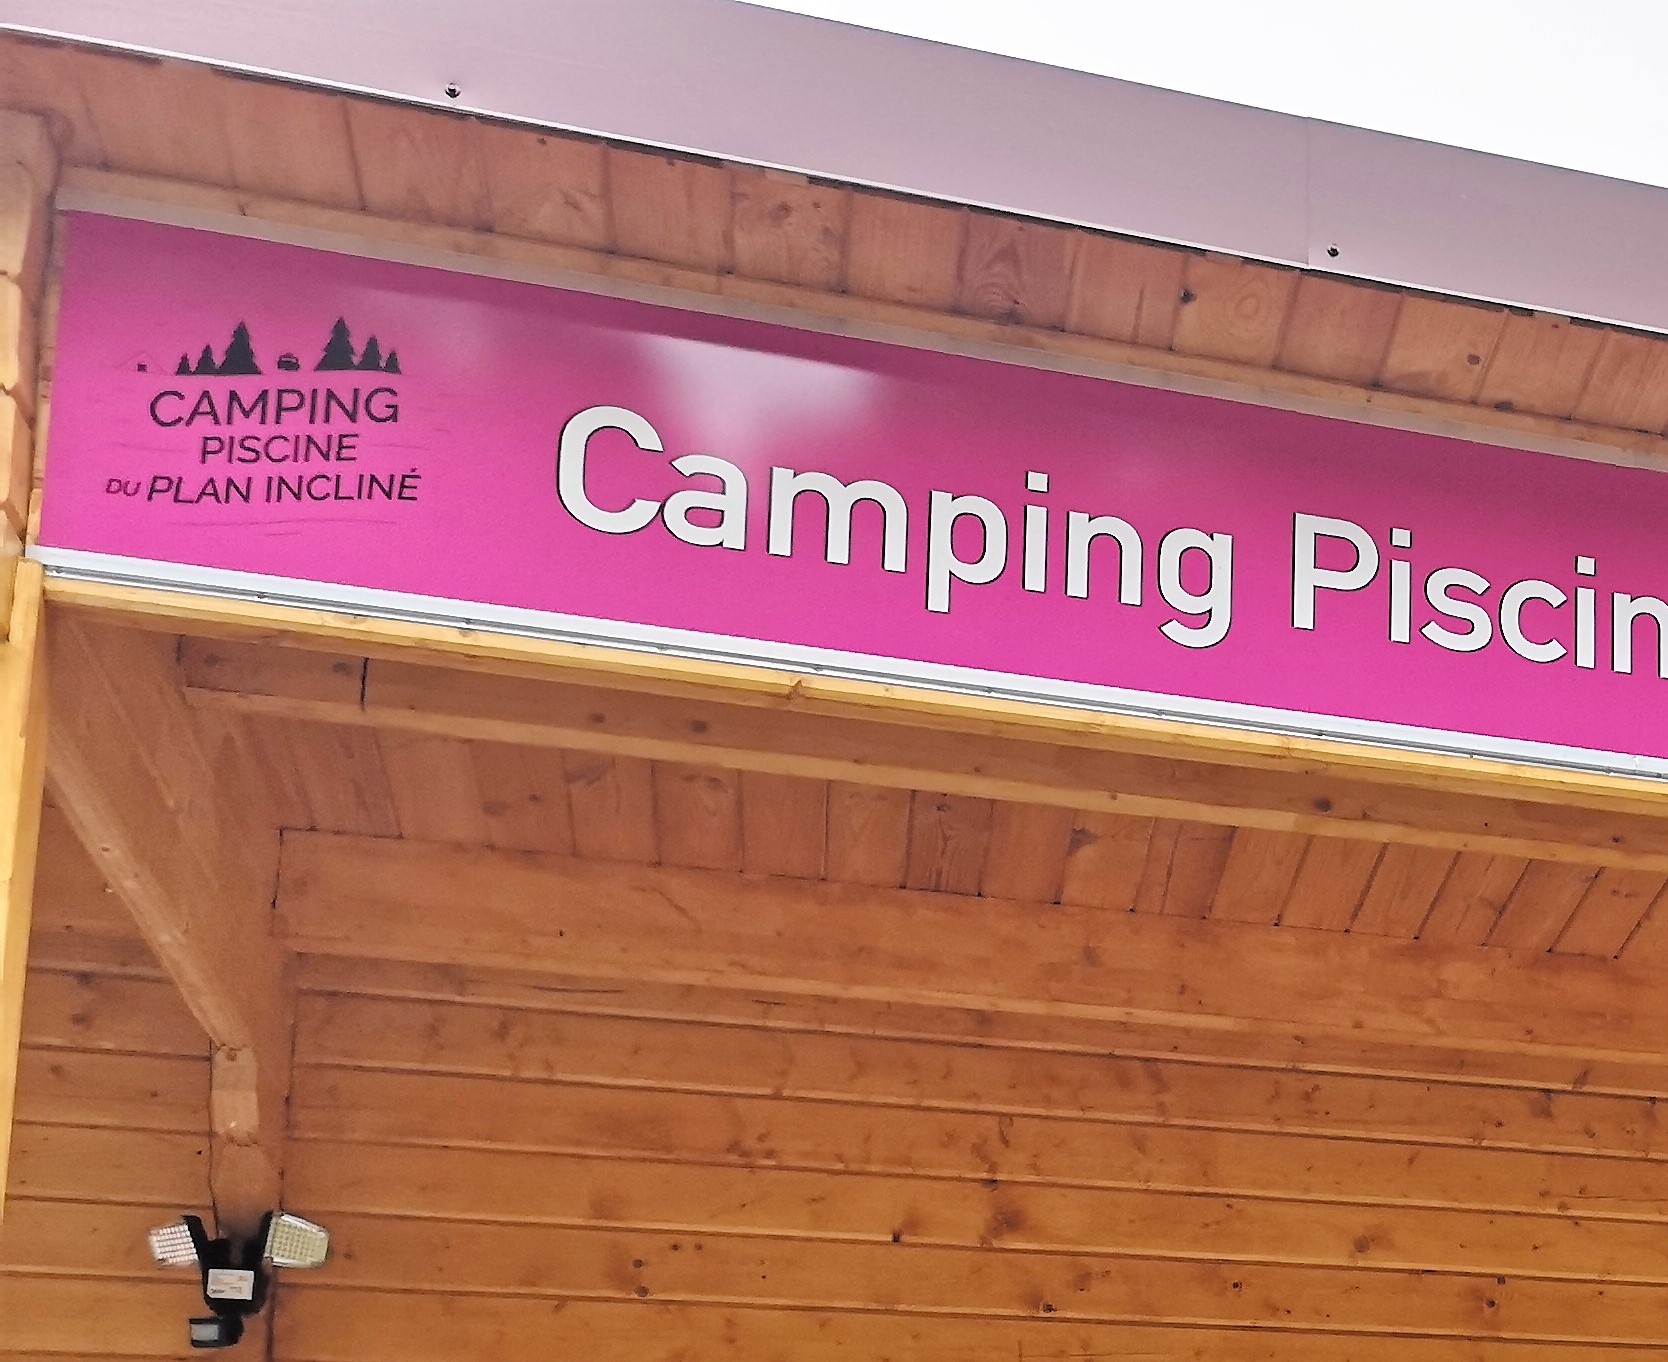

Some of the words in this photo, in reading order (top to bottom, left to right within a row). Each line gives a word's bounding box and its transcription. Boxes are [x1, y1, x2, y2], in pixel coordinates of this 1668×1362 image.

[149, 387, 400, 428] CAMPING
[199, 432, 359, 465] PISCINE
[105, 477, 141, 498] DU
[146, 475, 253, 505] PLAN
[265, 467, 422, 504] INCLINÉ
[556, 404, 1233, 648] Camping
